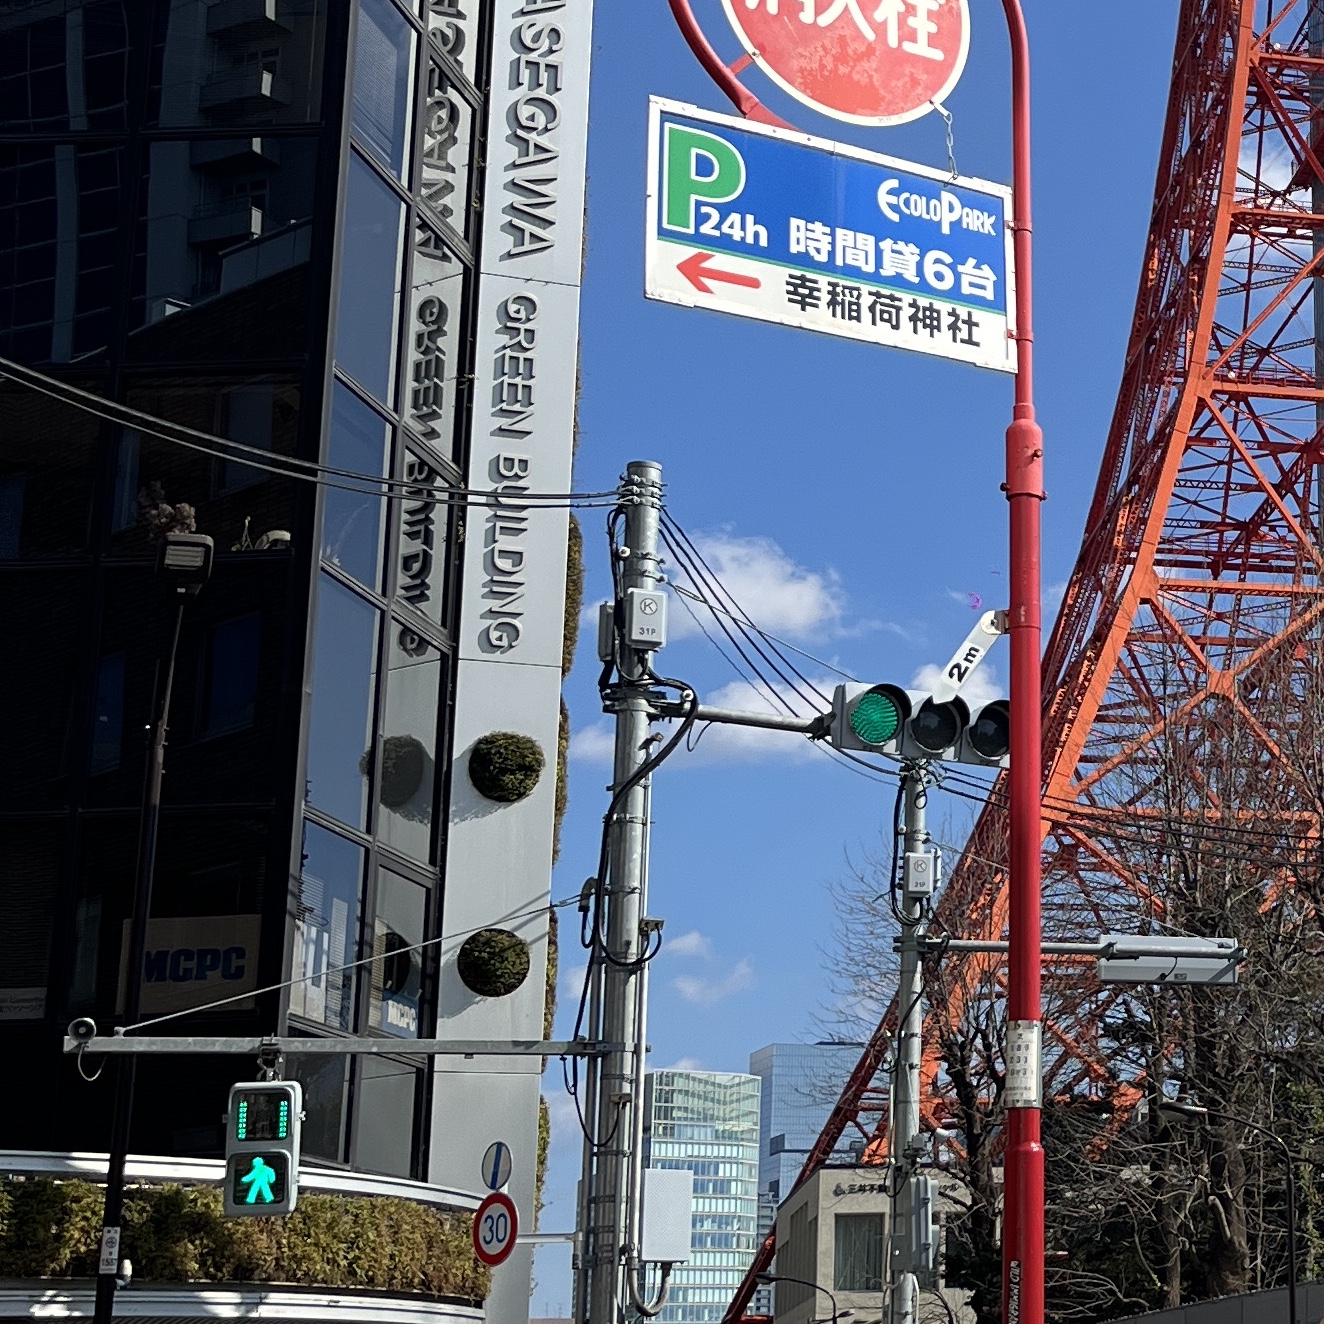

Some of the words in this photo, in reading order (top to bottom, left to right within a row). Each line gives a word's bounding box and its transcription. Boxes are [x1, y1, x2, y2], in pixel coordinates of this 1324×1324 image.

[662, 122, 746, 235] P
[699, 206, 768, 247] 24h
[789, 216, 998, 301] 時間貸6台
[785, 273, 981, 348] 幸稲荷神社
[501, 291, 540, 435] GREEN
[489, 453, 532, 648] BUILDING
[948, 646, 980, 684] 2m
[482, 1212, 508, 1245] 30
